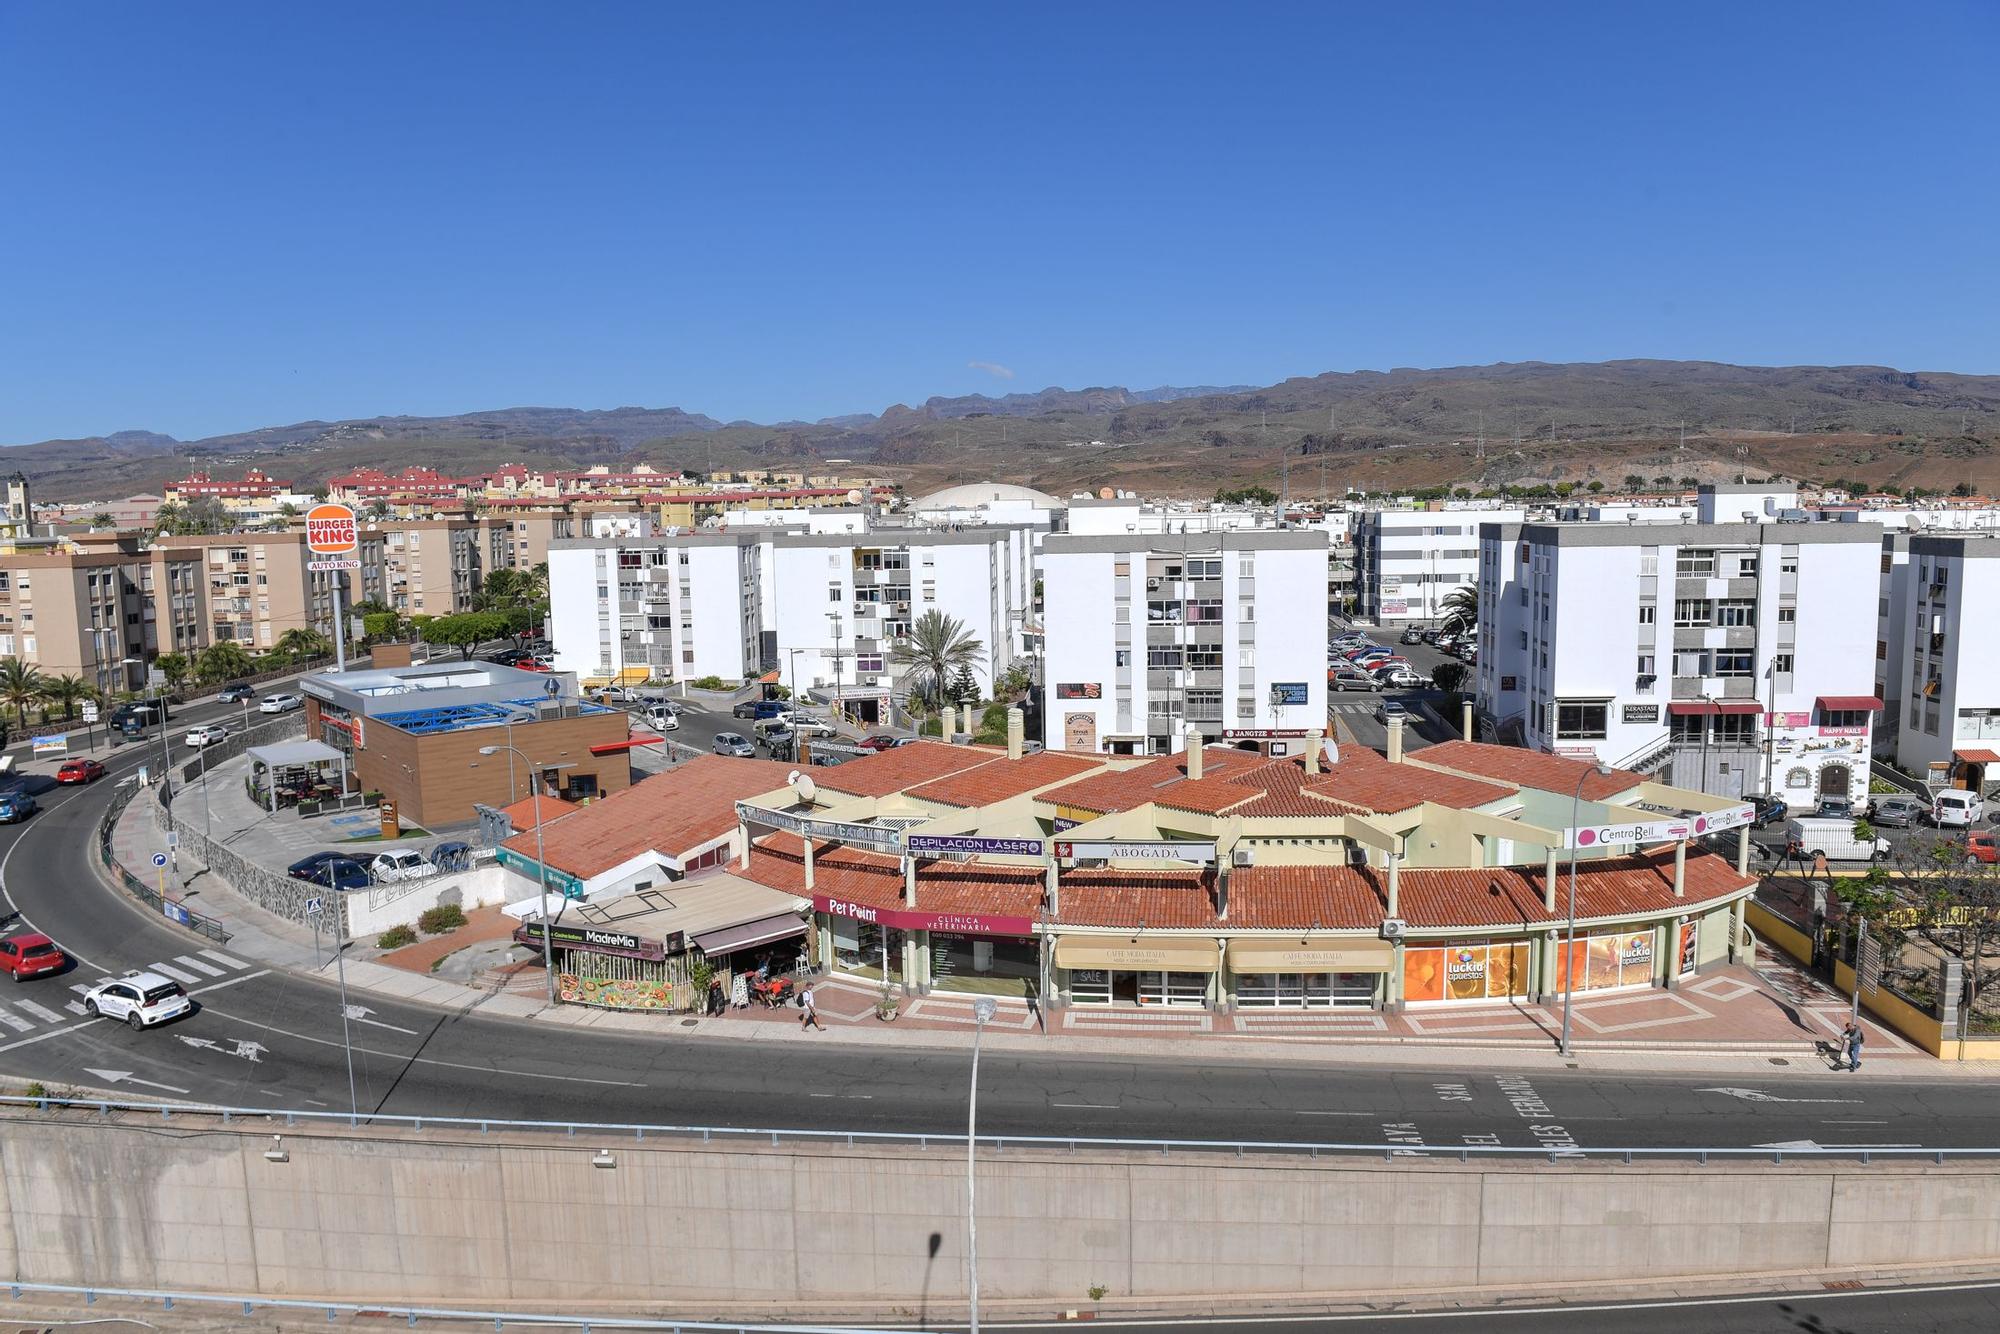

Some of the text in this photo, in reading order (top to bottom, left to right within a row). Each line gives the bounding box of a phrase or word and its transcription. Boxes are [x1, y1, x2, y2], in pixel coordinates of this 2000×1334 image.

[308, 520, 354, 530] BURGER
[309, 529, 355, 544] KING
[311, 560, 358, 570] AUTO KING
[1055, 819, 1073, 829] NEW
[910, 837, 1028, 851] DEPILACIÓN LÁSER
[1111, 848, 1181, 858] ABOGADA
[829, 899, 877, 922] Pet Point
[937, 915, 979, 924] CLÍNICA
[927, 921, 991, 931] VETERINARIA
[586, 930, 635, 948] MadreMia
[1080, 972, 1101, 983] SALE
[1432, 1083, 1473, 1102] SAN
[1494, 1074, 1555, 1118] FERNANDO
[1381, 1122, 1430, 1157] PAYA
